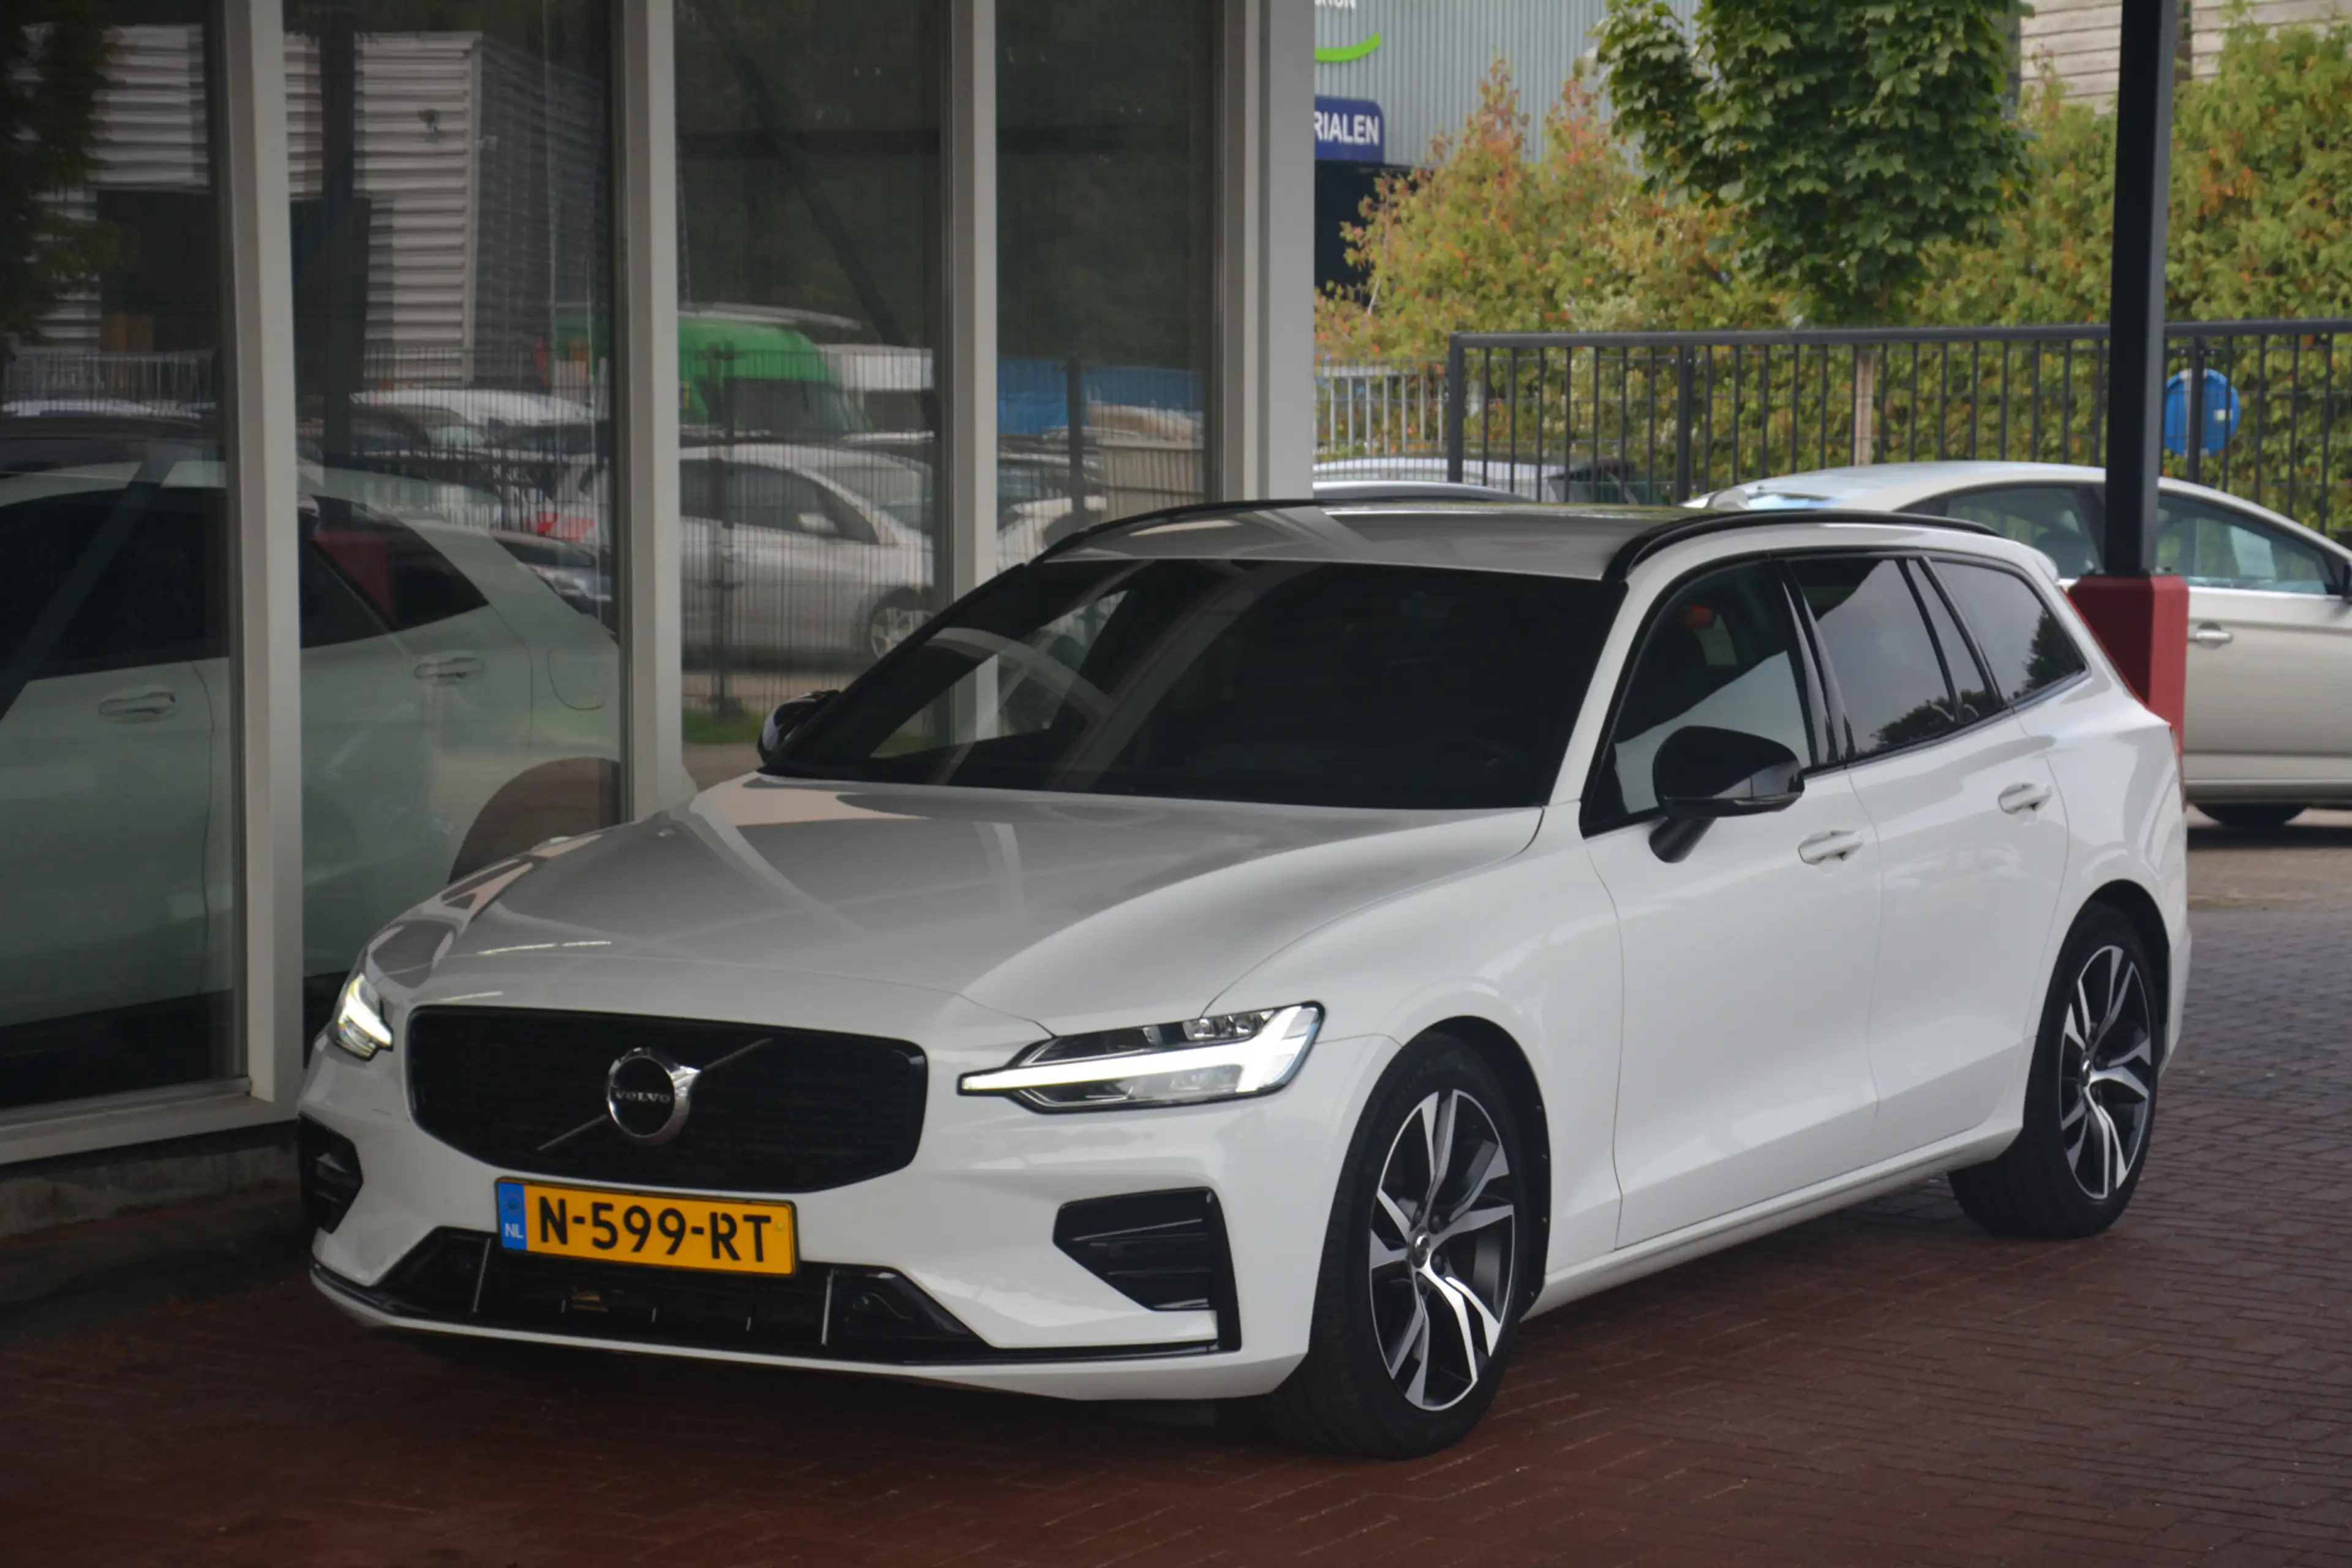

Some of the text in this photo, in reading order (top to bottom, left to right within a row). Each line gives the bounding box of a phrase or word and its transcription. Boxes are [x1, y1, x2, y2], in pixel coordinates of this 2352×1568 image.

[615, 1091, 671, 1102] VOLVO
[505, 1223, 524, 1239] NL
[539, 1196, 772, 1262] N-599-RT
